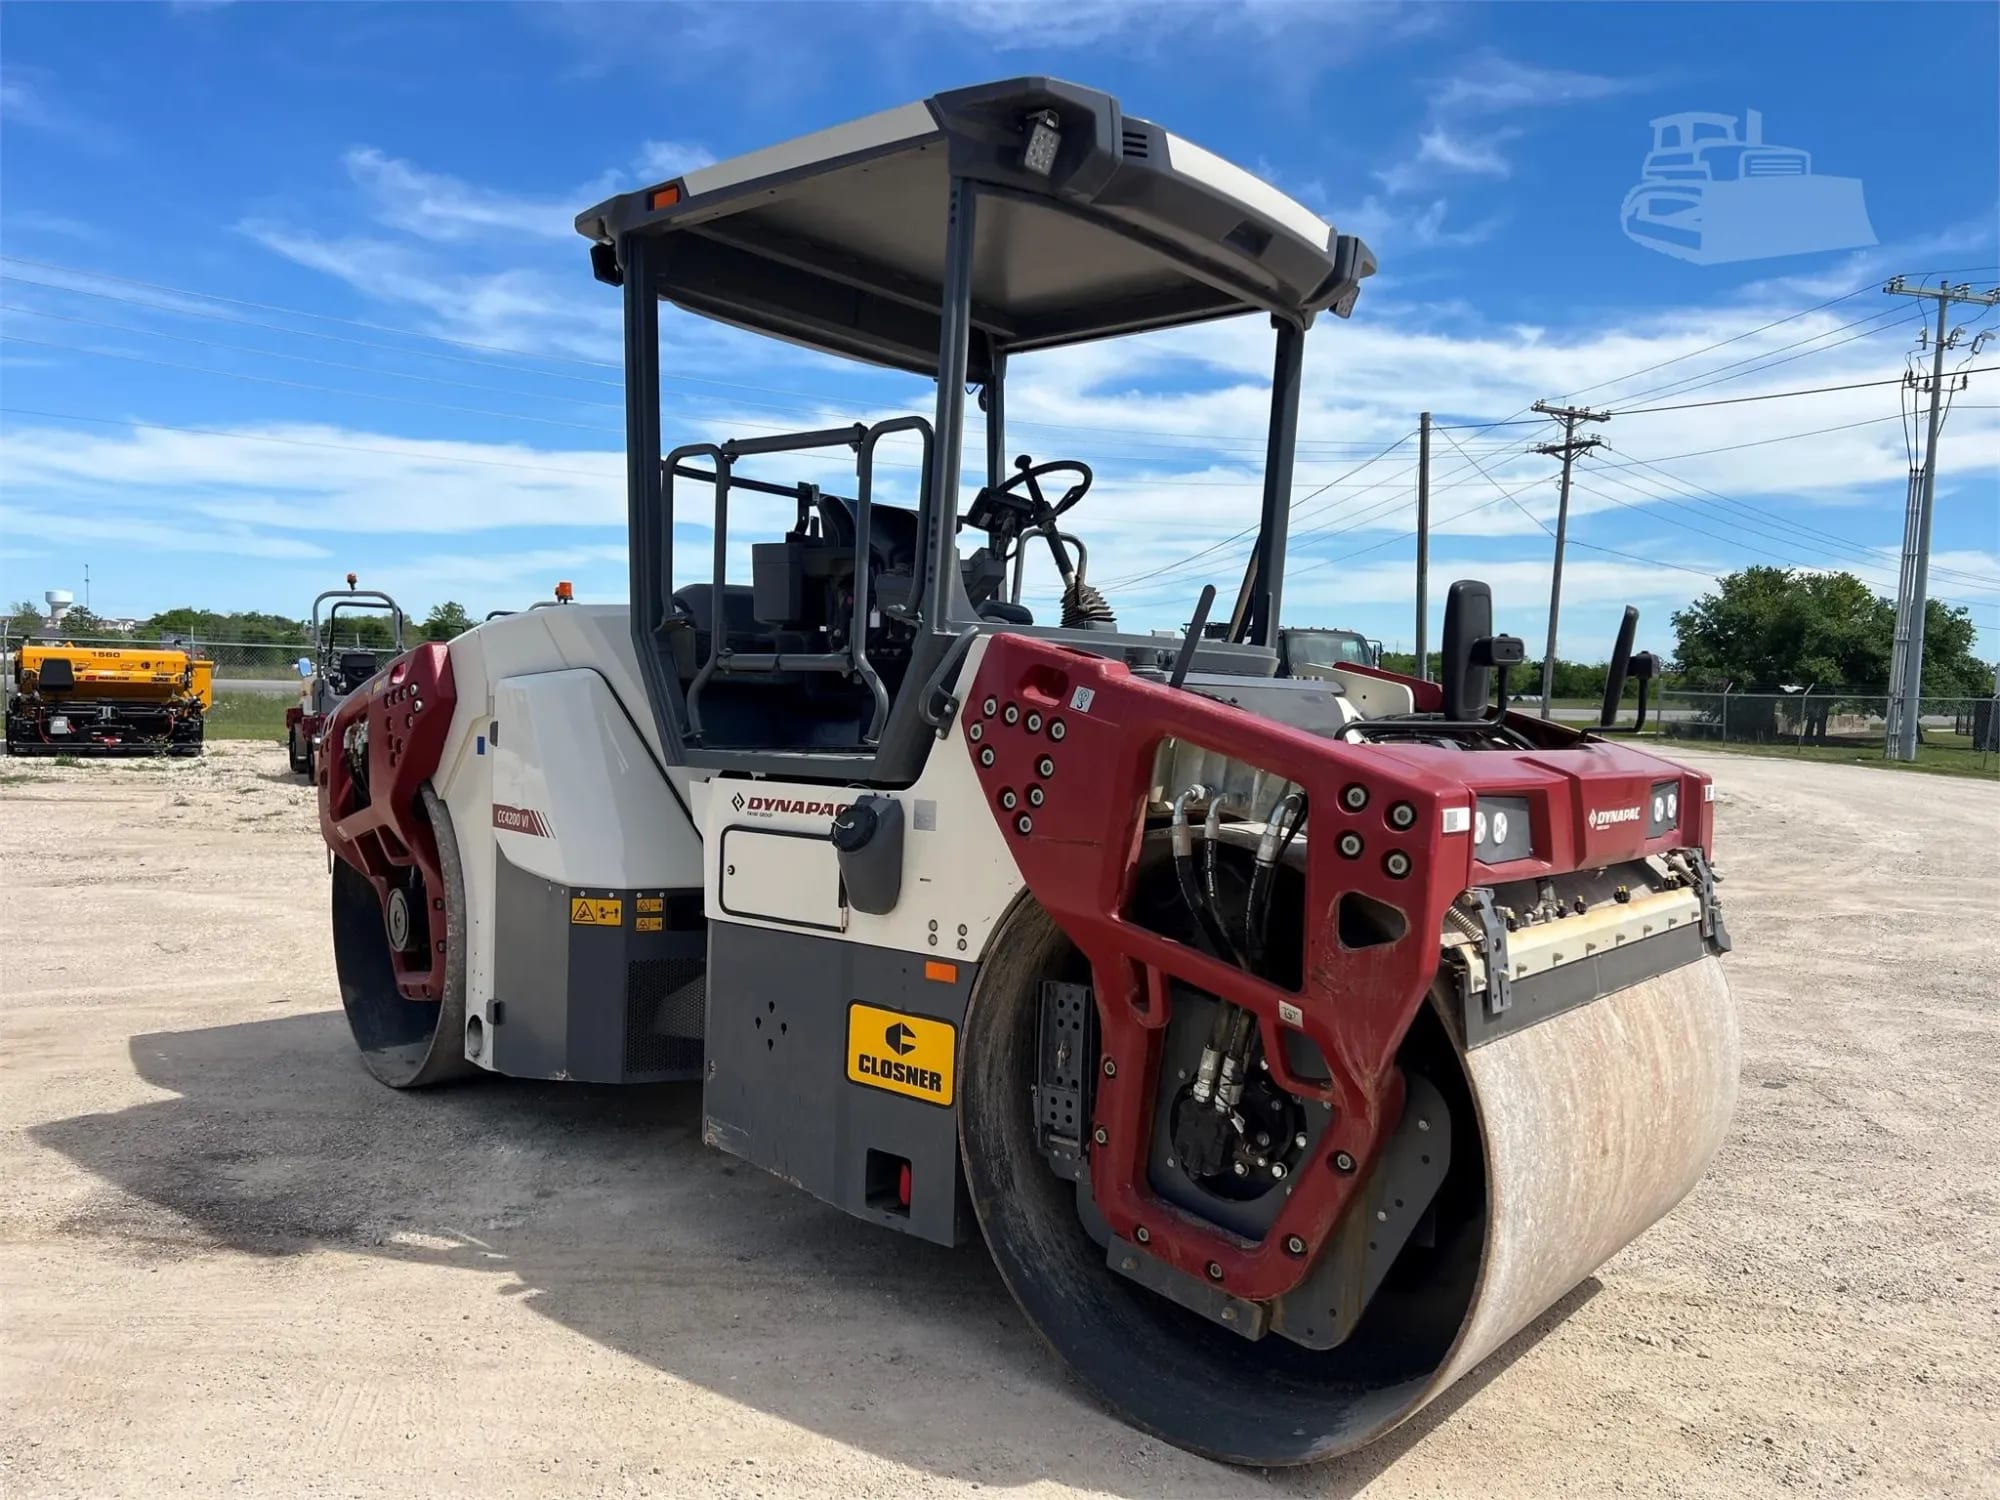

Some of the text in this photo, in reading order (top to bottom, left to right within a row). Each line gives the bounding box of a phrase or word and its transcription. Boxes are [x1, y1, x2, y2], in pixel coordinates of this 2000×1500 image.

[497, 809, 529, 829] CC4200 VI
[1597, 806, 1641, 825] DYNAPAC
[858, 1053, 942, 1093] CLOSNER
